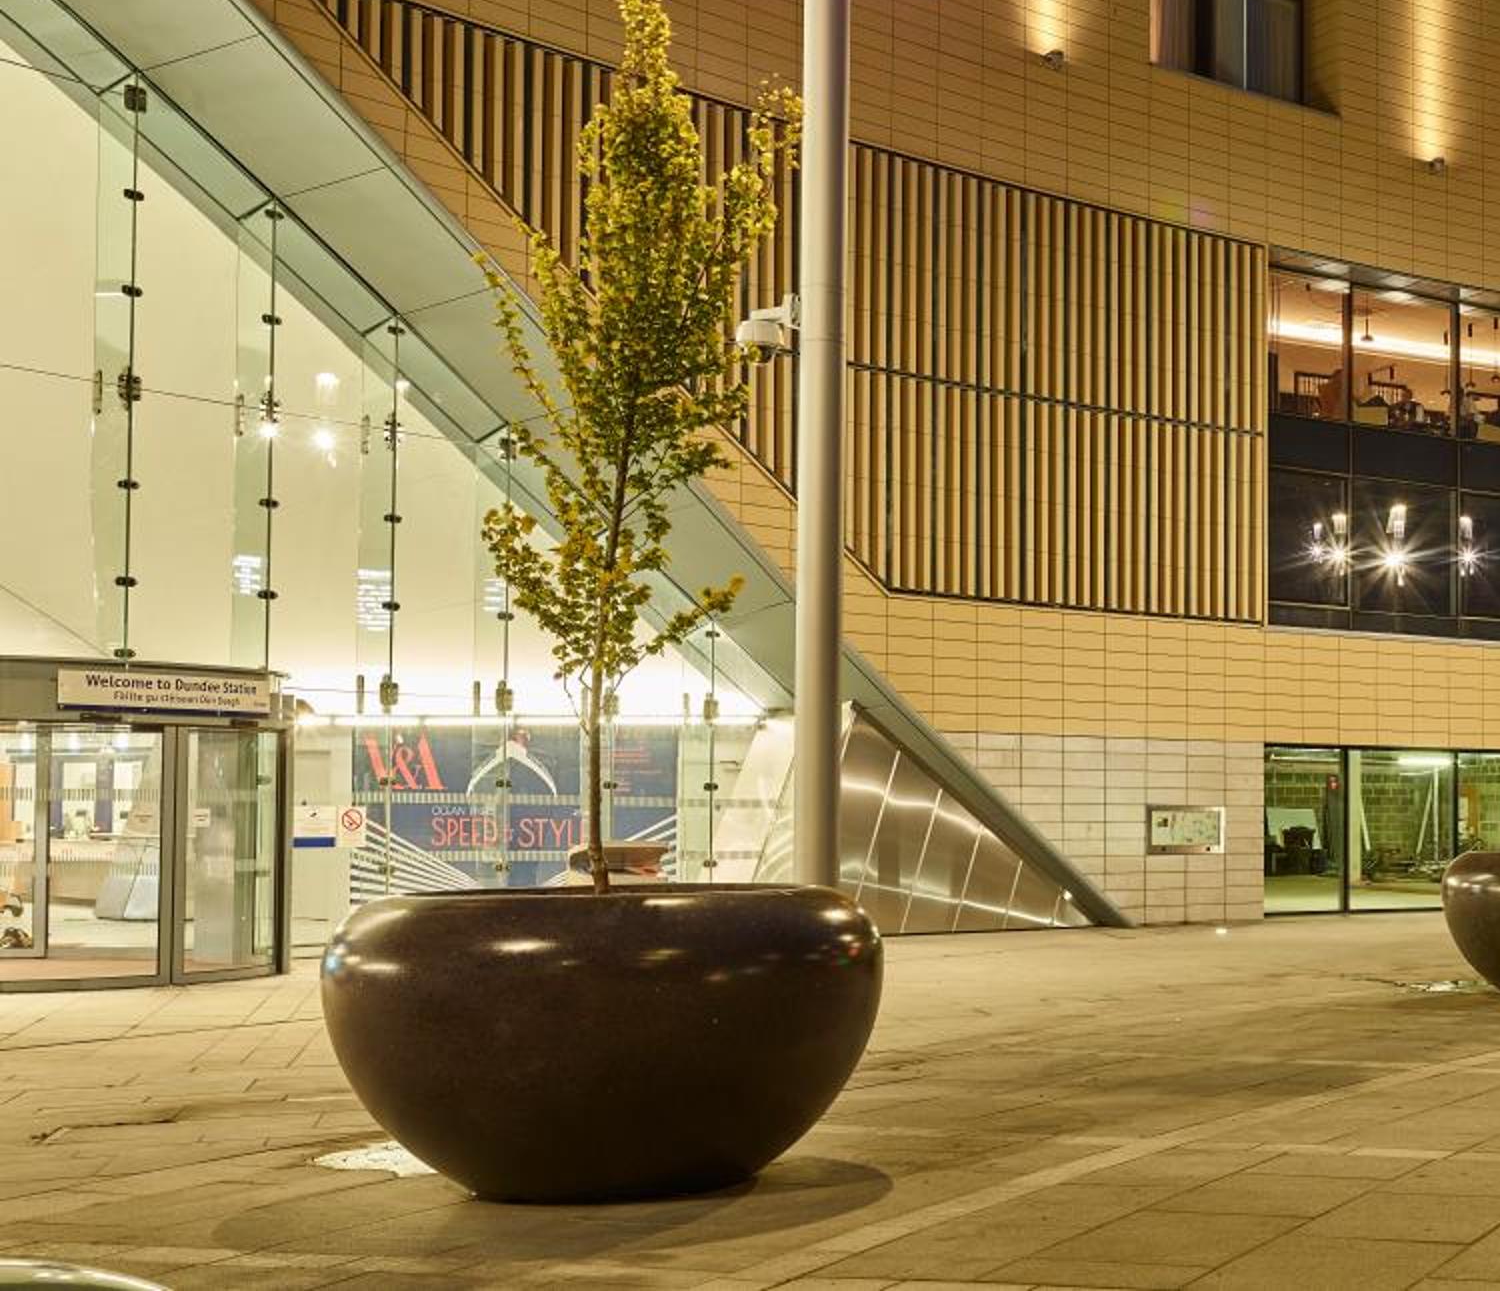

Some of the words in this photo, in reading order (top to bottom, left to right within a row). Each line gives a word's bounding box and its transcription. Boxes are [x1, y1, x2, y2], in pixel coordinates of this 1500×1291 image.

[85, 673, 153, 690] Welcome
[156, 676, 171, 690] to
[175, 678, 221, 694] Dundee
[223, 680, 257, 696] Station
[362, 727, 448, 790] V&A
[431, 817, 498, 848] SPEED
